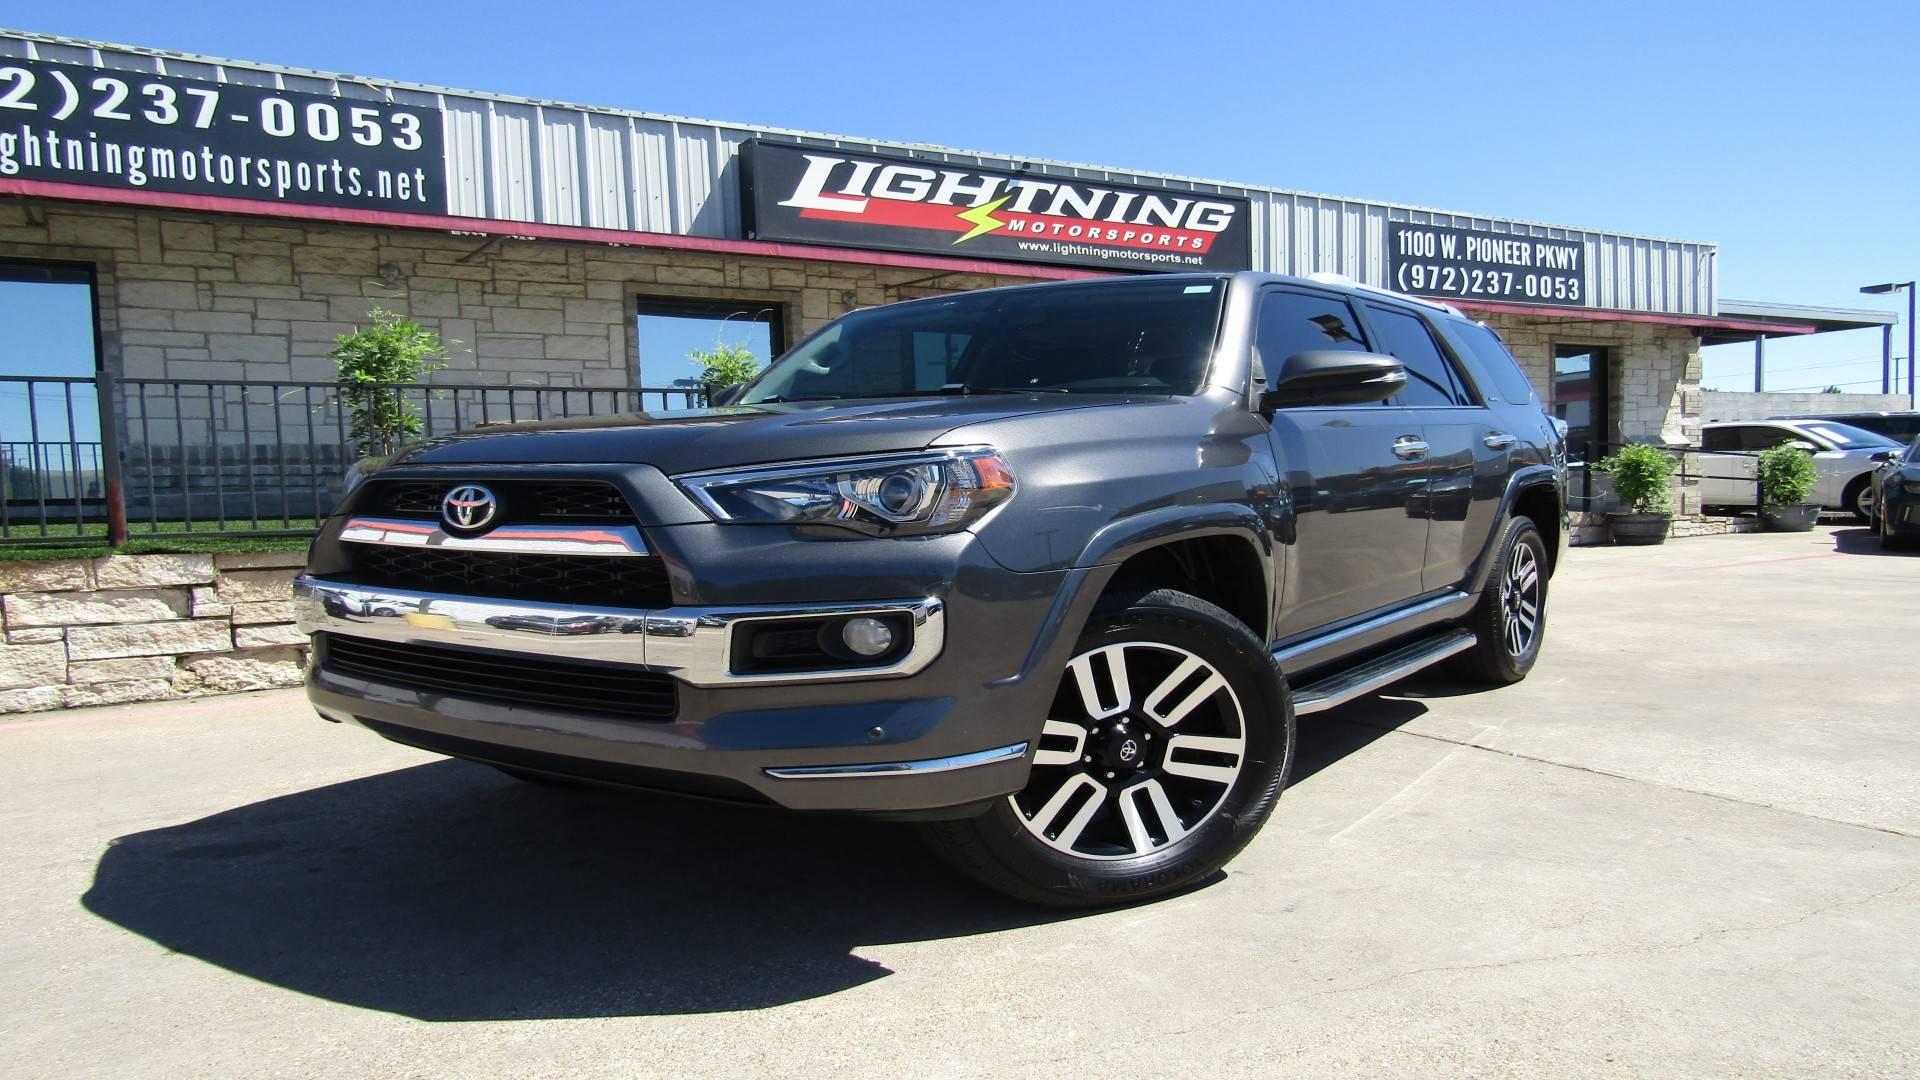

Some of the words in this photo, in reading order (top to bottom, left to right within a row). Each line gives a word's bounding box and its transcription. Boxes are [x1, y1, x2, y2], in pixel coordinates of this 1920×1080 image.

[777, 155, 1236, 232] LIGHTNING
[1008, 219, 1203, 249] MOTORSPORTS
[1018, 241, 1203, 265] www.lightningmotorsports.net
[1398, 230, 1435, 258] 1100
[1440, 234, 1462, 260] W.
[1466, 236, 1531, 266] PIONEER
[1535, 243, 1578, 270] PKWY
[1397, 262, 1579, 300] (972)237-0053
